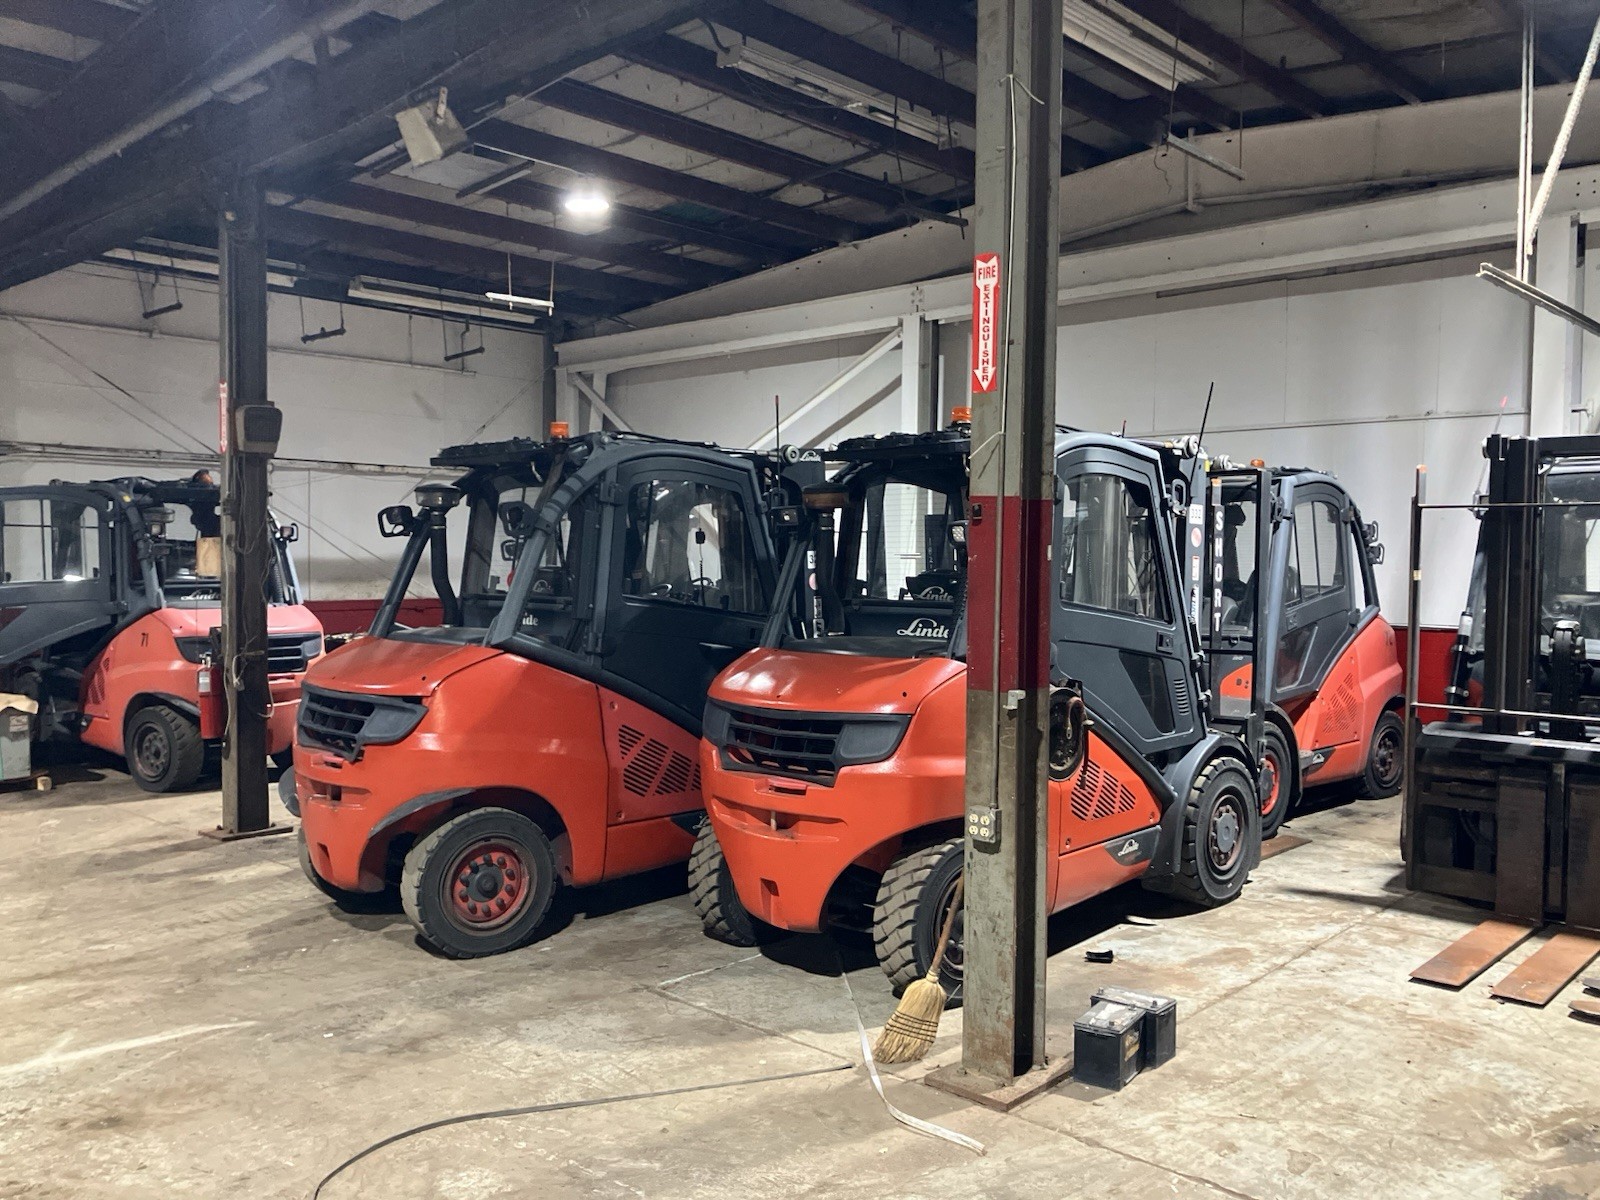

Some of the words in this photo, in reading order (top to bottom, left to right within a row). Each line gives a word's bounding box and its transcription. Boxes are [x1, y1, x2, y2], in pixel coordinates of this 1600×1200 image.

[978, 265, 996, 280] FIRE
[982, 284, 990, 382] EXTINGUISHER
[1214, 511, 1224, 632] SHORT
[141, 632, 149, 647] 71
